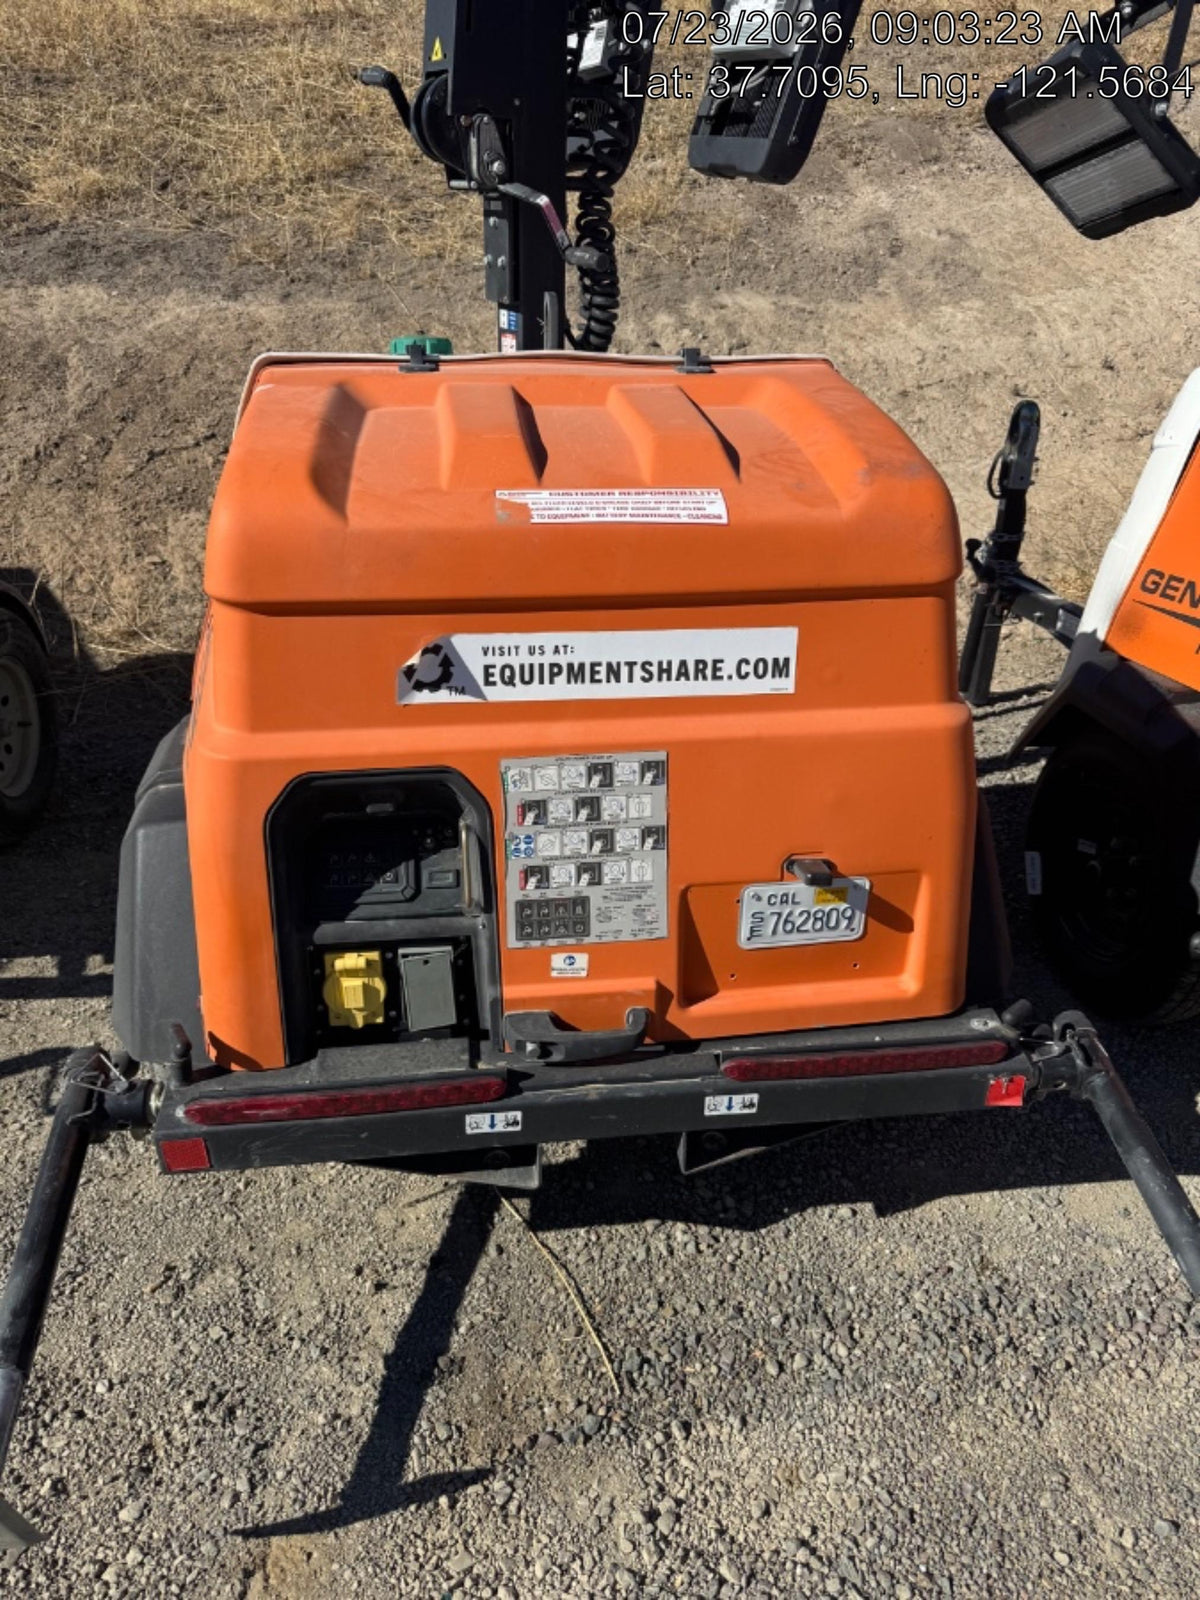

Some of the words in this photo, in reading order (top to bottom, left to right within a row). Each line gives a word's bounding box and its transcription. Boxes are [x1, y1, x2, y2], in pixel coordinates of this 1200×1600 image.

[481, 645, 521, 657] VISIT
[528, 645, 546, 656] US
[552, 644, 576, 656] AT:
[482, 656, 791, 688] EQUIPMENTSHARE.COM
[767, 893, 800, 906] CAL
[769, 906, 856, 937] 762809
